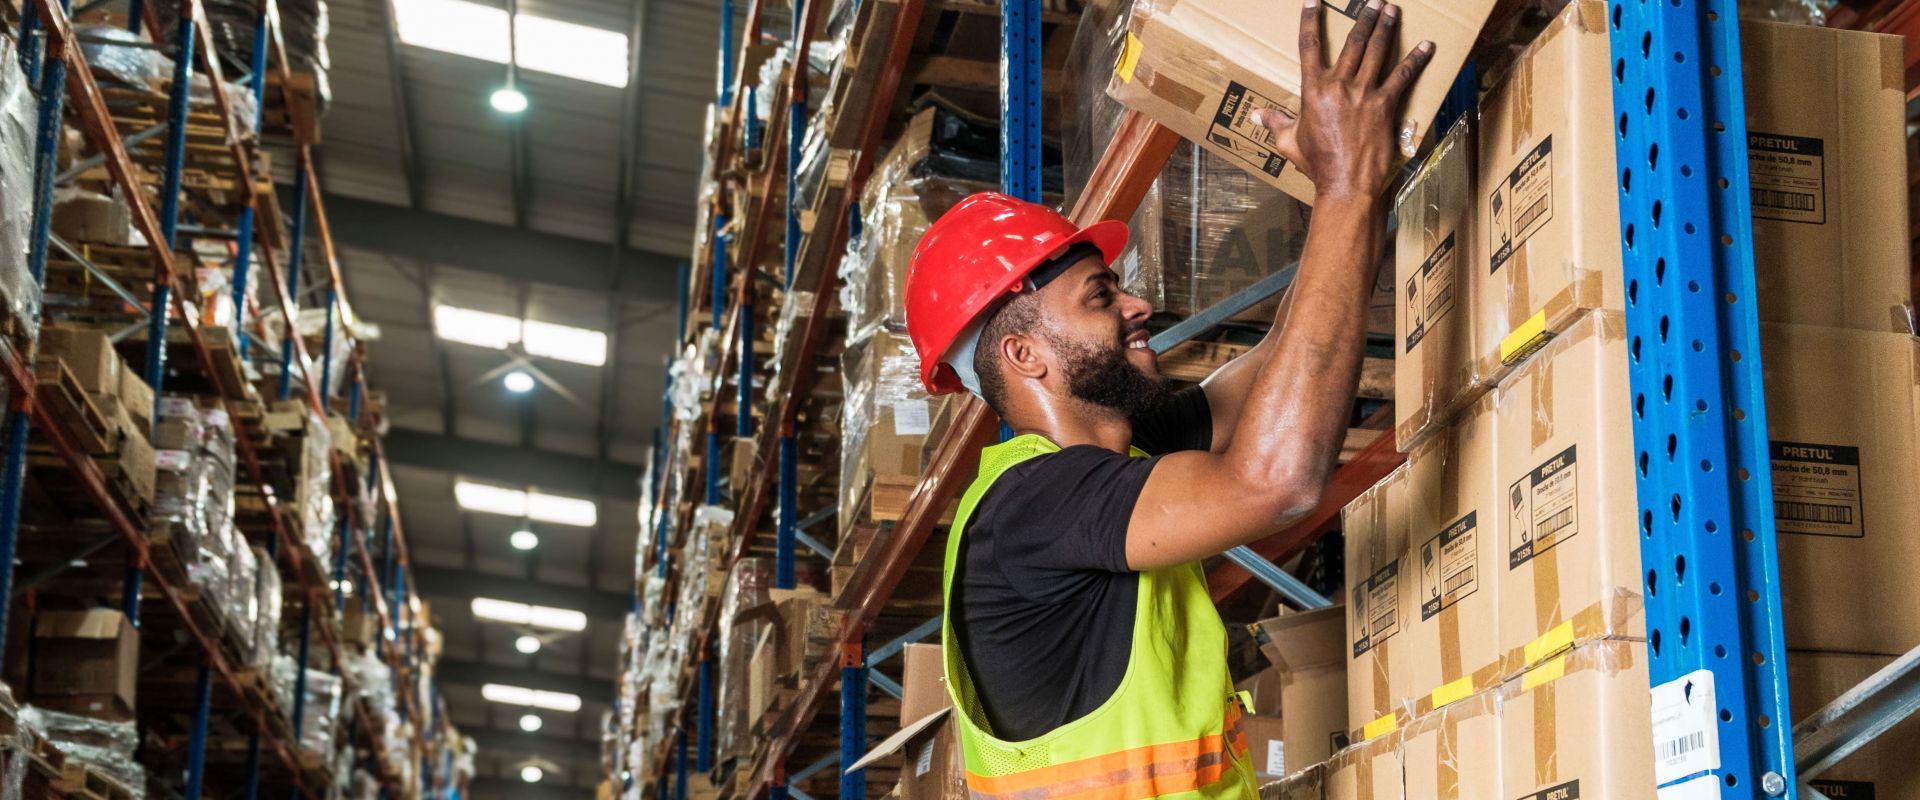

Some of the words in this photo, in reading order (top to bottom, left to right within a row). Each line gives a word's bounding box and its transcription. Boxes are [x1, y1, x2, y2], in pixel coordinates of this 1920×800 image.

[1751, 136, 1799, 151] PRETUL
[1519, 150, 1541, 176] PRETUL
[1778, 155, 1796, 165] 50,8
[1797, 159, 1813, 167] mm
[1782, 446, 1833, 460] PRETUL
[1541, 455, 1565, 478] PRETUL
[1772, 463, 1799, 472] Brocha
[1800, 464, 1811, 473] de
[1812, 466, 1831, 476] 50,8
[1832, 469, 1848, 477] mm
[1448, 520, 1467, 539] PRETUL
